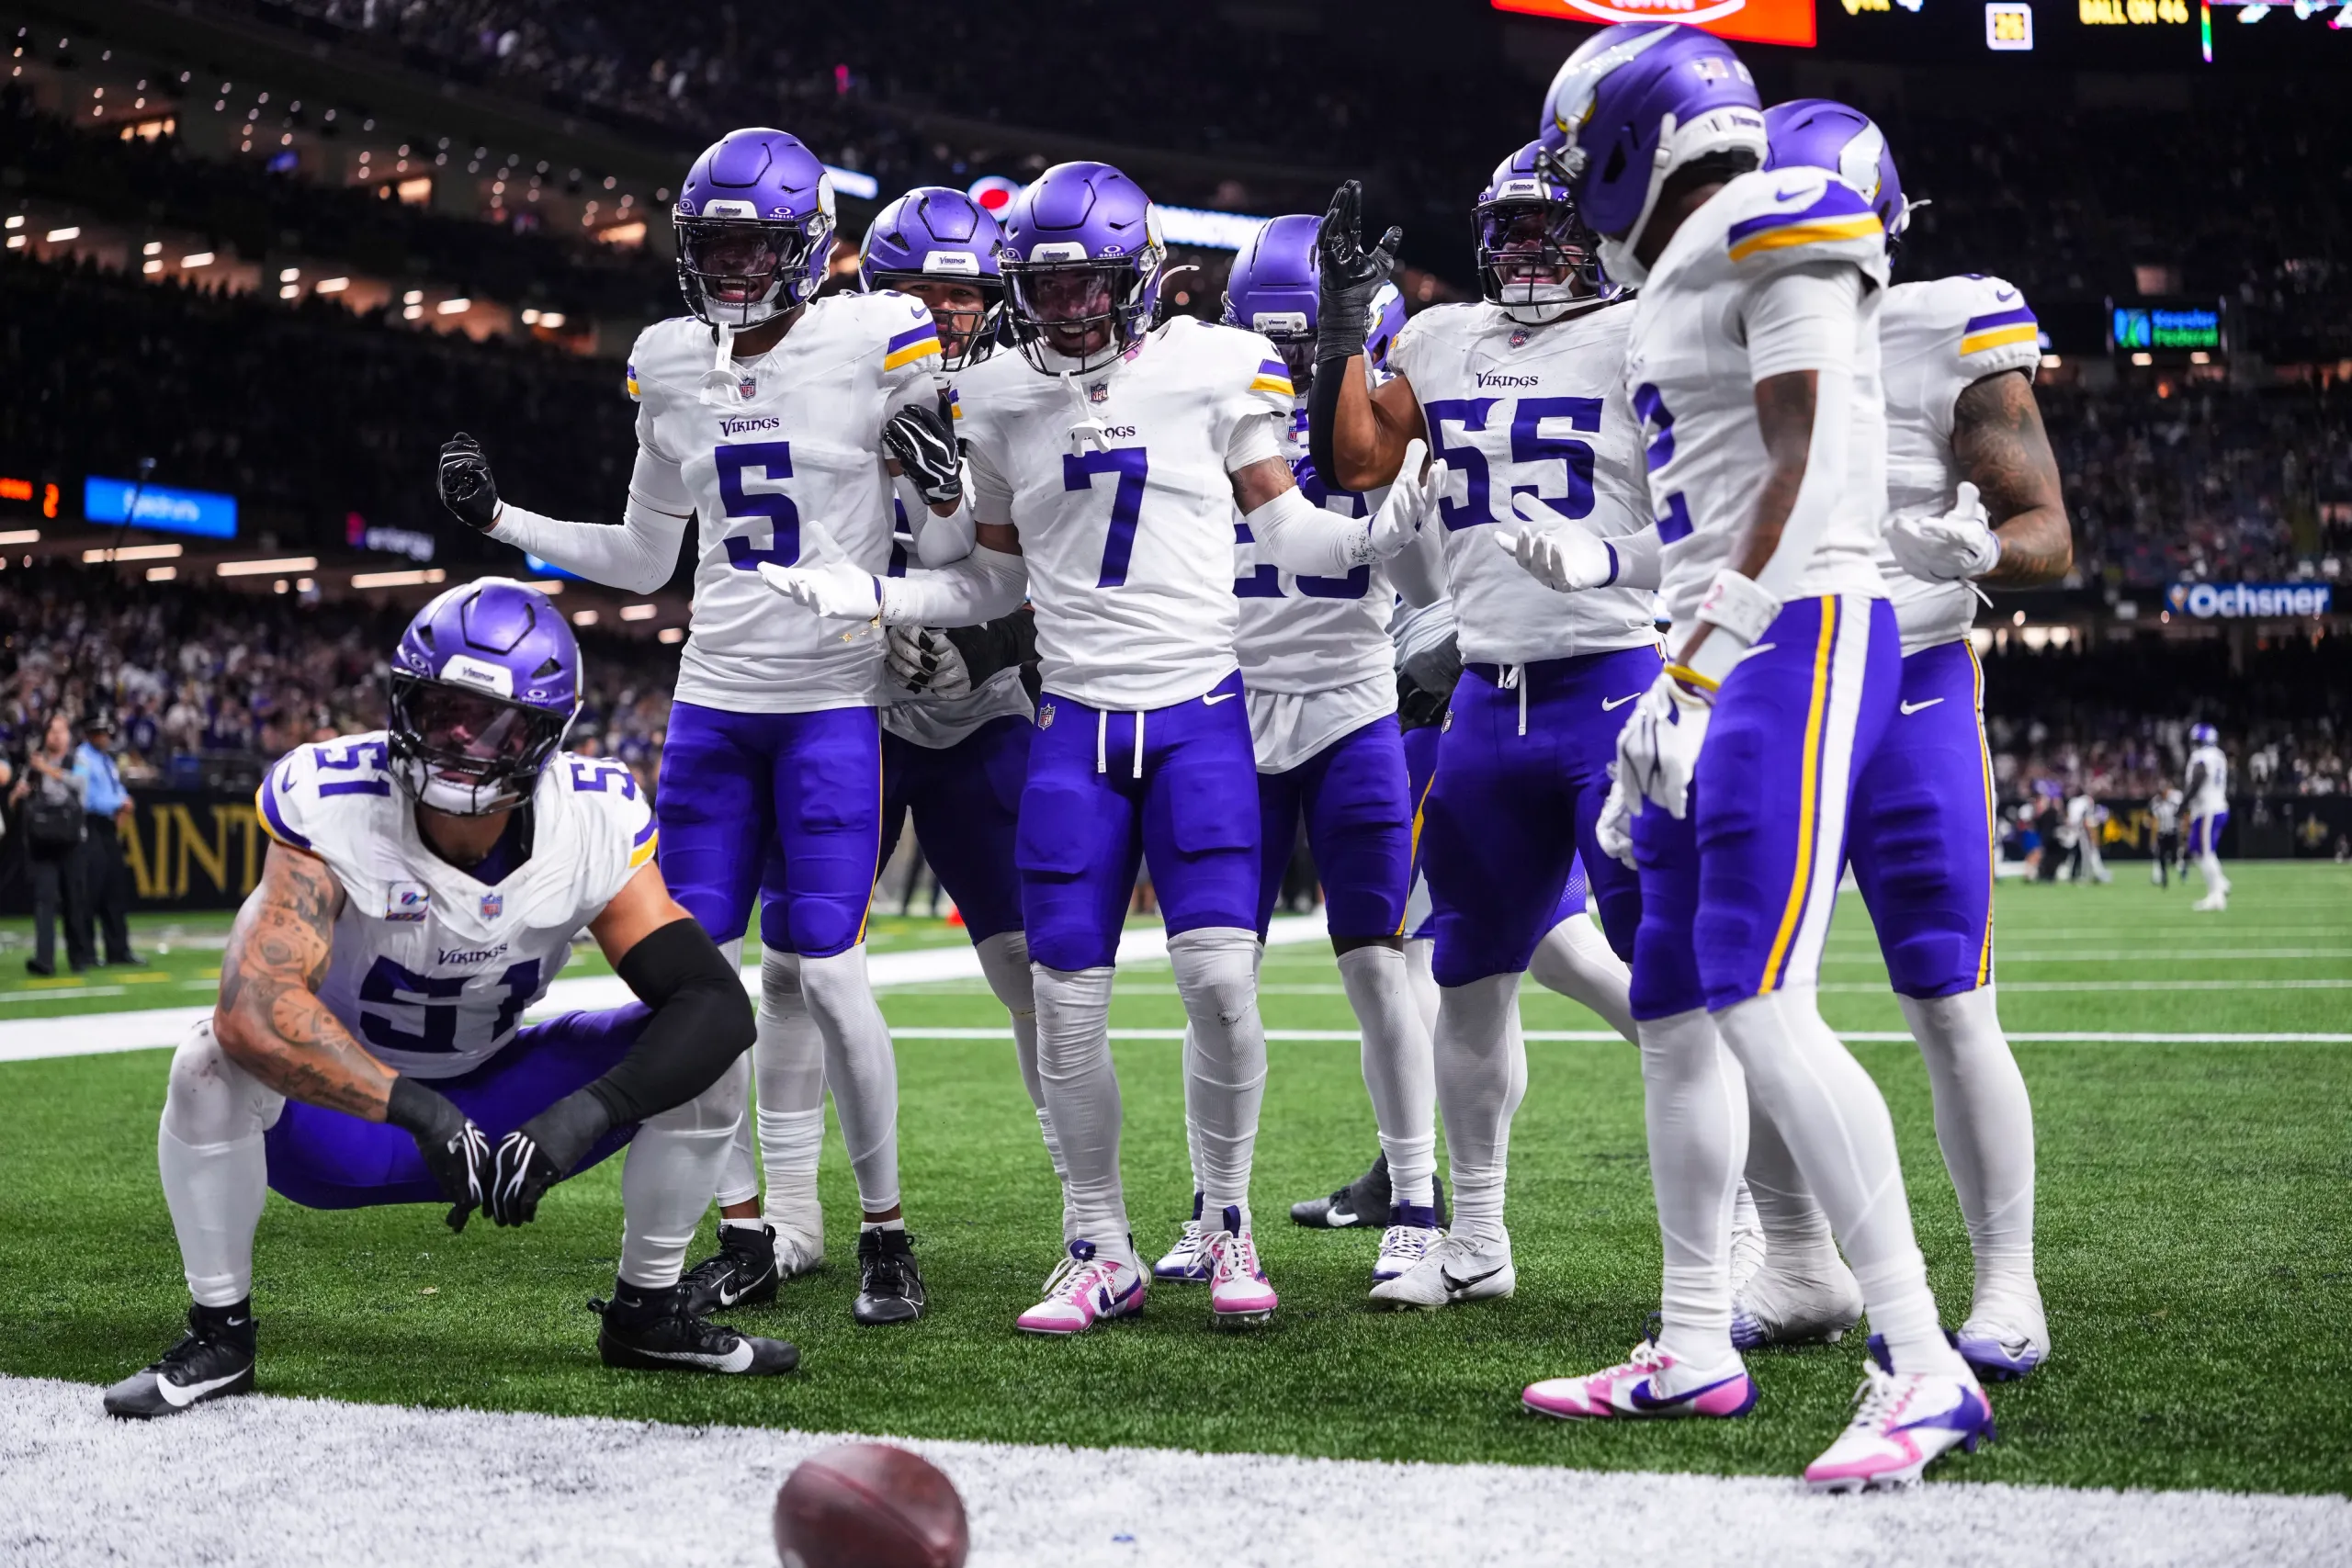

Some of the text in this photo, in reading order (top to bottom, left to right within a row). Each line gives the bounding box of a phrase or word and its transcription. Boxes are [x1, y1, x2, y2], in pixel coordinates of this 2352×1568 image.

[939, 256, 966, 265] VIKINGS
[1476, 367, 1539, 389] VIKINGS
[718, 415, 780, 437] VIKINGS
[1423, 397, 1603, 530] 55
[715, 441, 800, 571] 5
[1063, 447, 1148, 588] 7
[2188, 583, 2329, 617] Ochsner
[313, 740, 391, 798] 51
[569, 753, 636, 801] 5
[117, 801, 260, 898] AINT
[438, 942, 507, 965] VIKINGS
[358, 954, 541, 1054] 51
